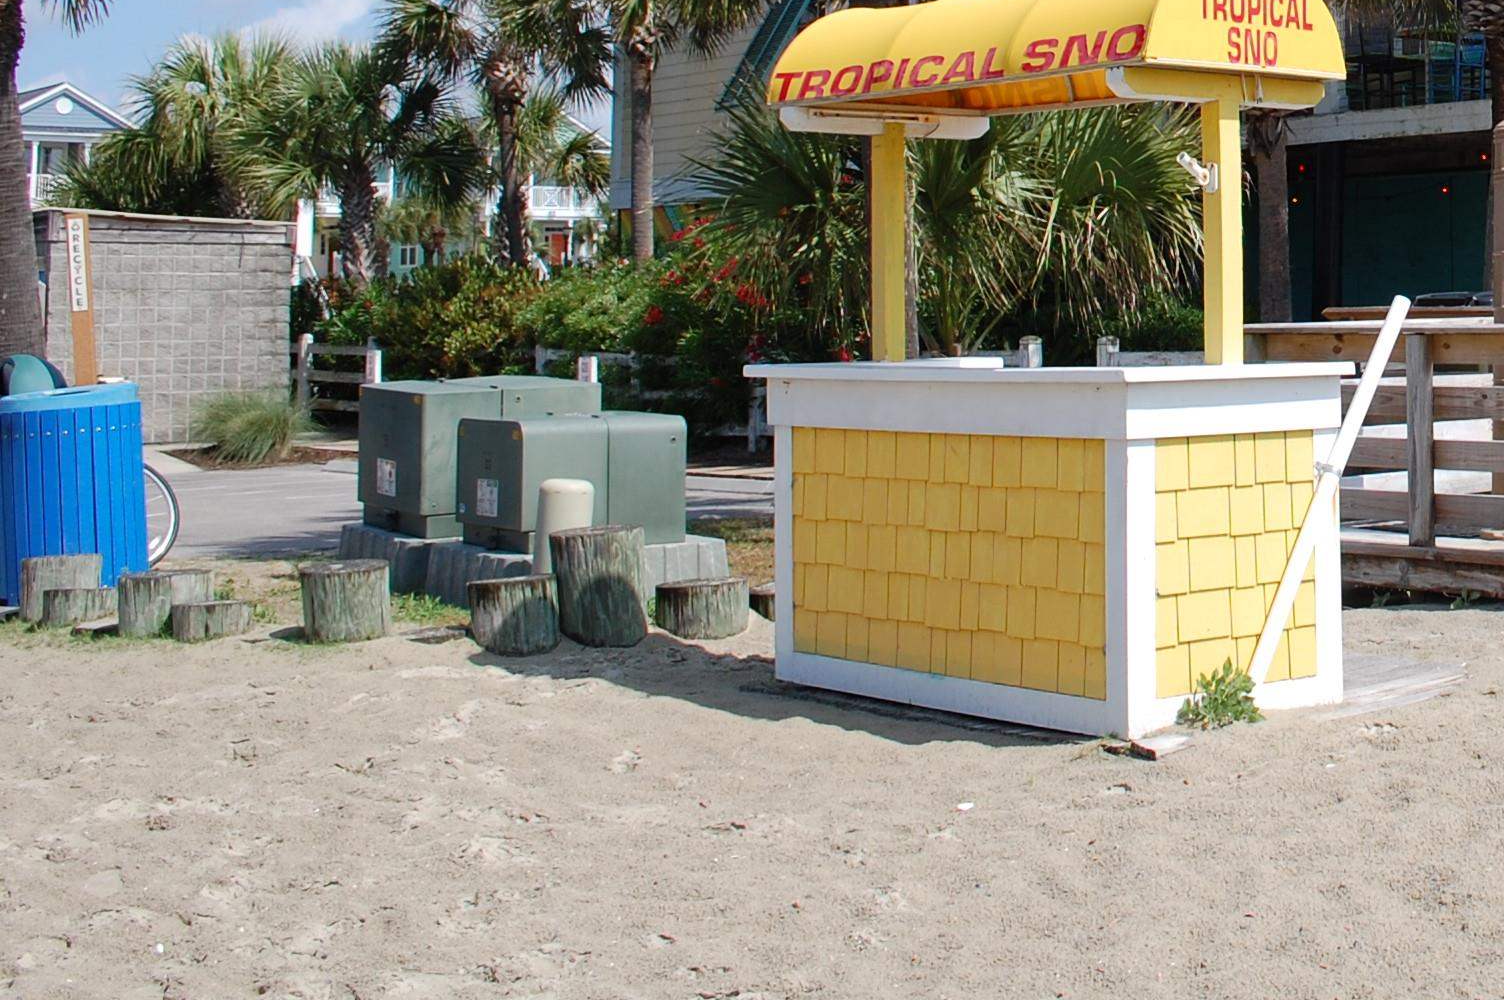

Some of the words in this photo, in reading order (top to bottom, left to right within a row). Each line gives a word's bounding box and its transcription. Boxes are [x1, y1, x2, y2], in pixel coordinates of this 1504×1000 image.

[774, 50, 1005, 102] TROPICAL
[1021, 23, 1147, 73] SNO
[1228, 26, 1278, 66] SNO
[72, 234, 83, 307] RECYCLE
